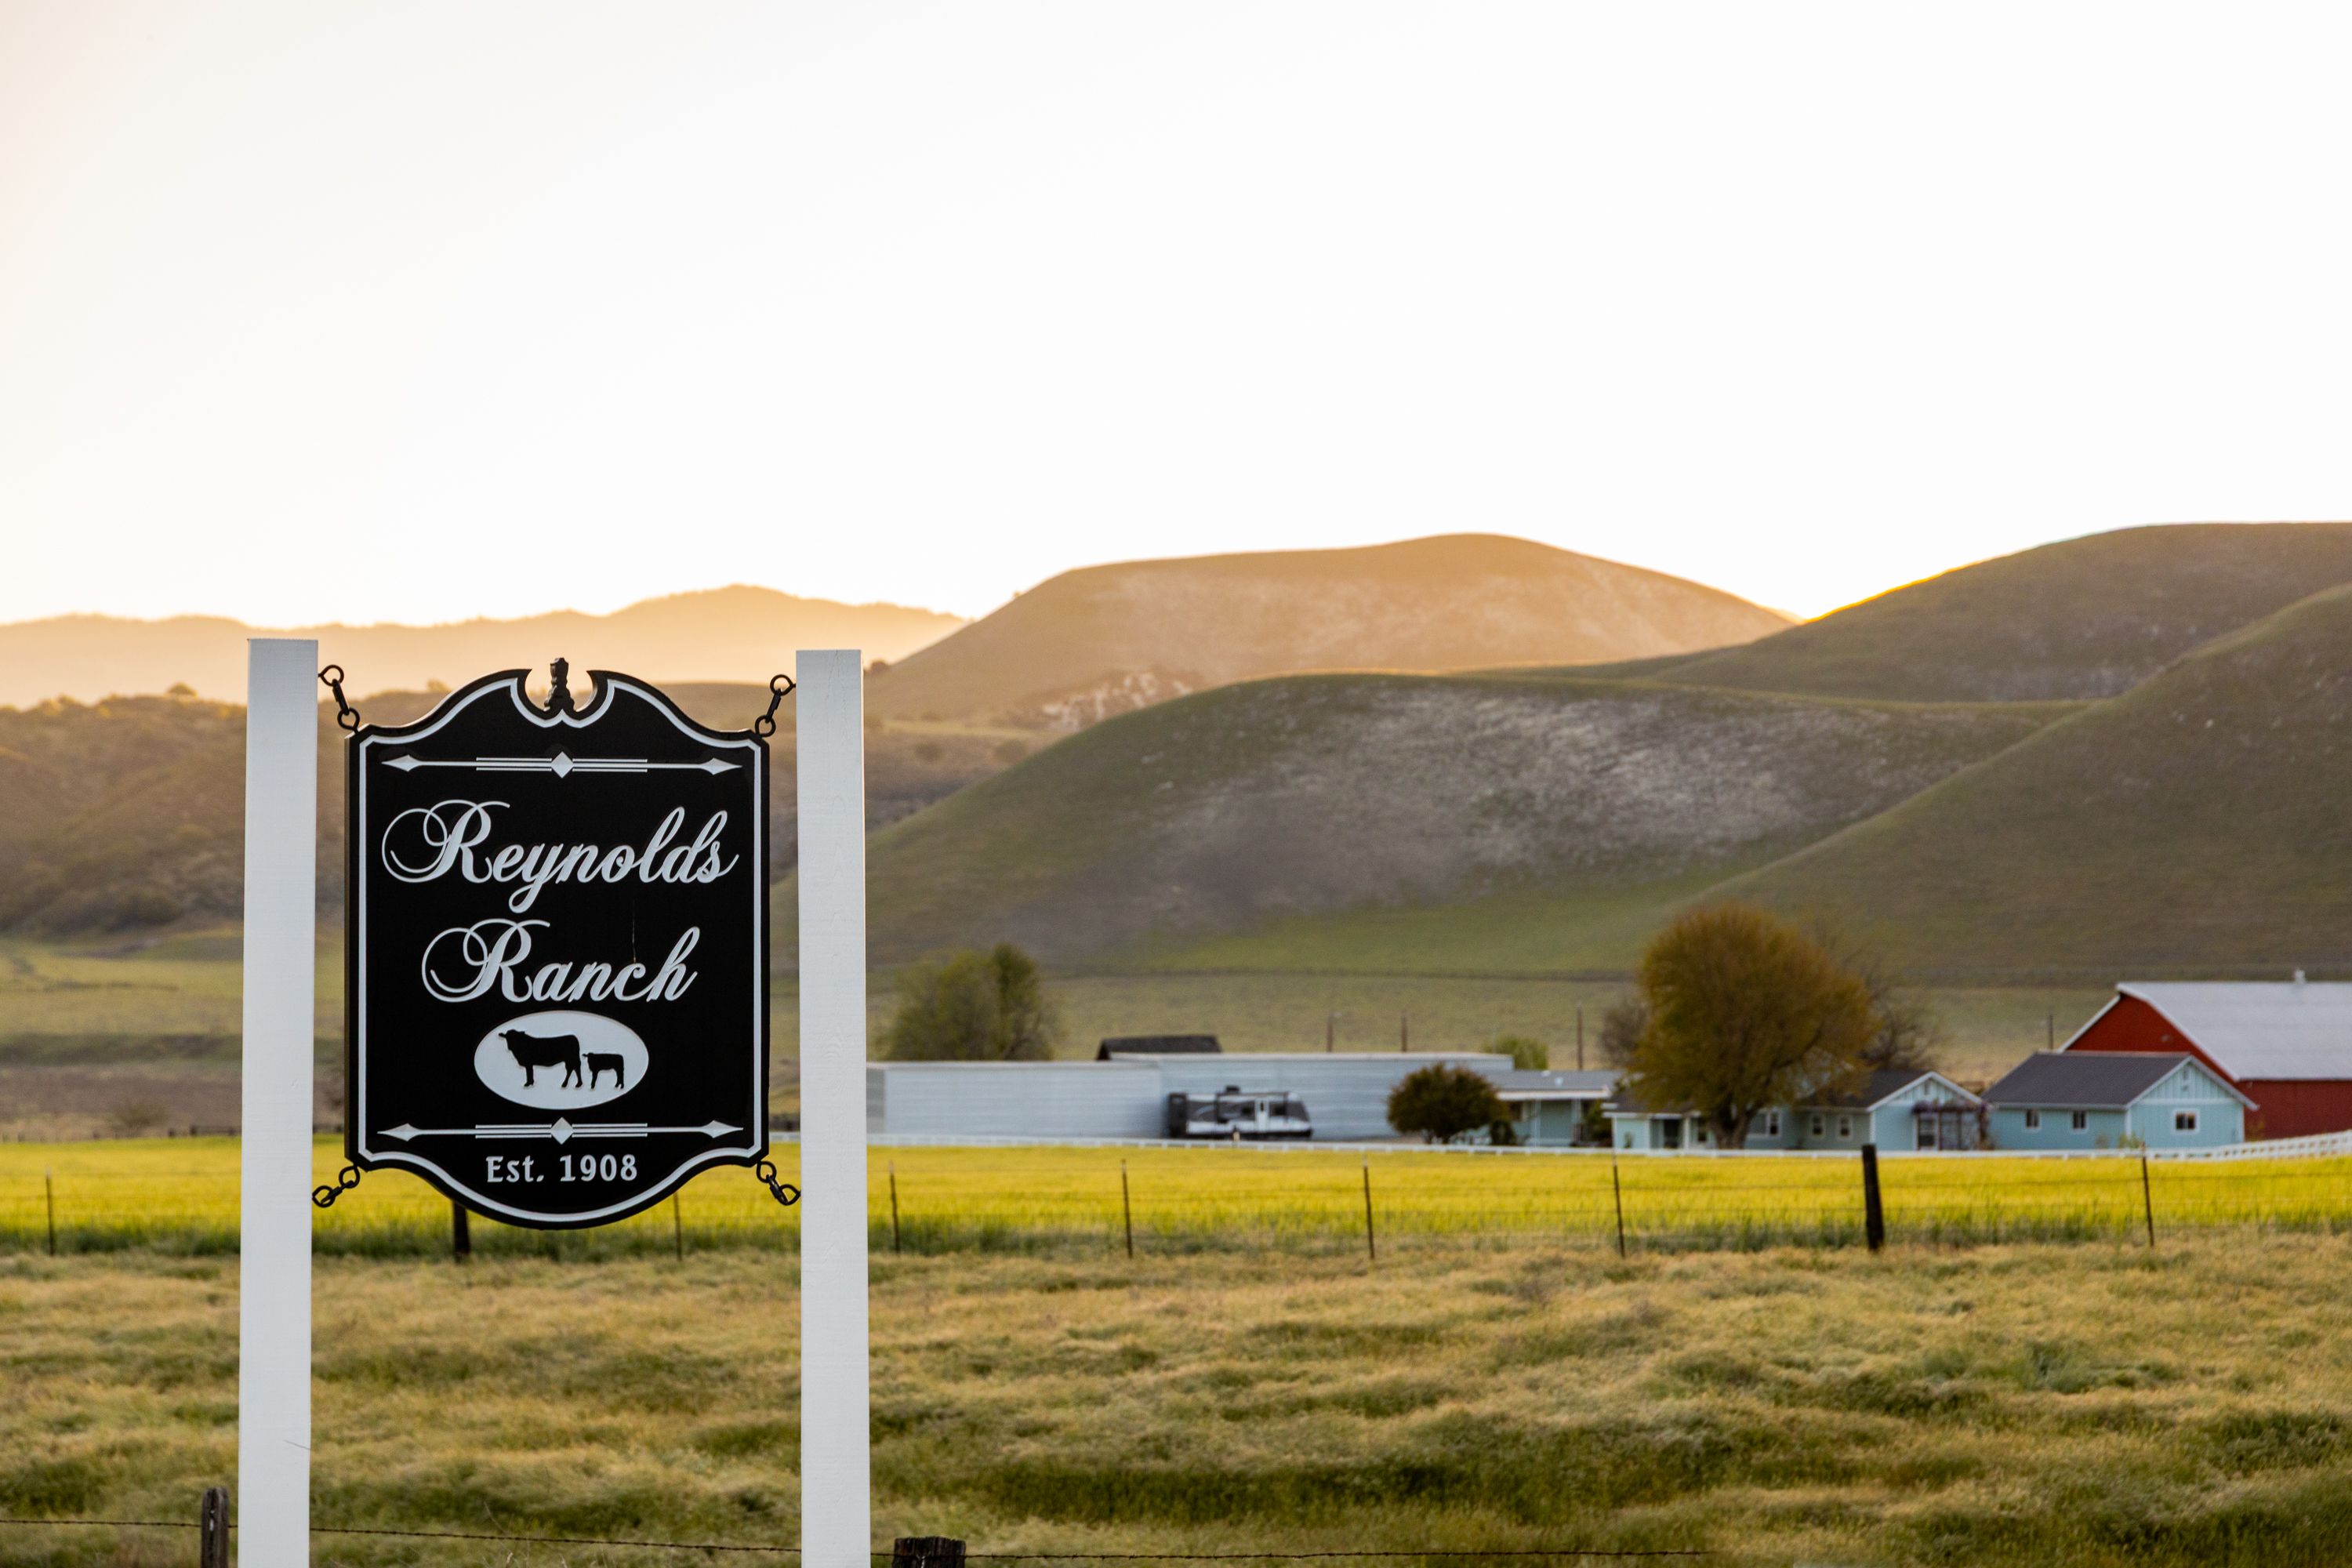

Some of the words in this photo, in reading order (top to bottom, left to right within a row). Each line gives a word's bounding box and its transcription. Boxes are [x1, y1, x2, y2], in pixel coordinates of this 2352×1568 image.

[381, 799, 739, 913] Reynolds
[421, 918, 700, 1003] Ranch
[485, 1156, 545, 1183] Est.
[559, 1154, 638, 1181] 1908
